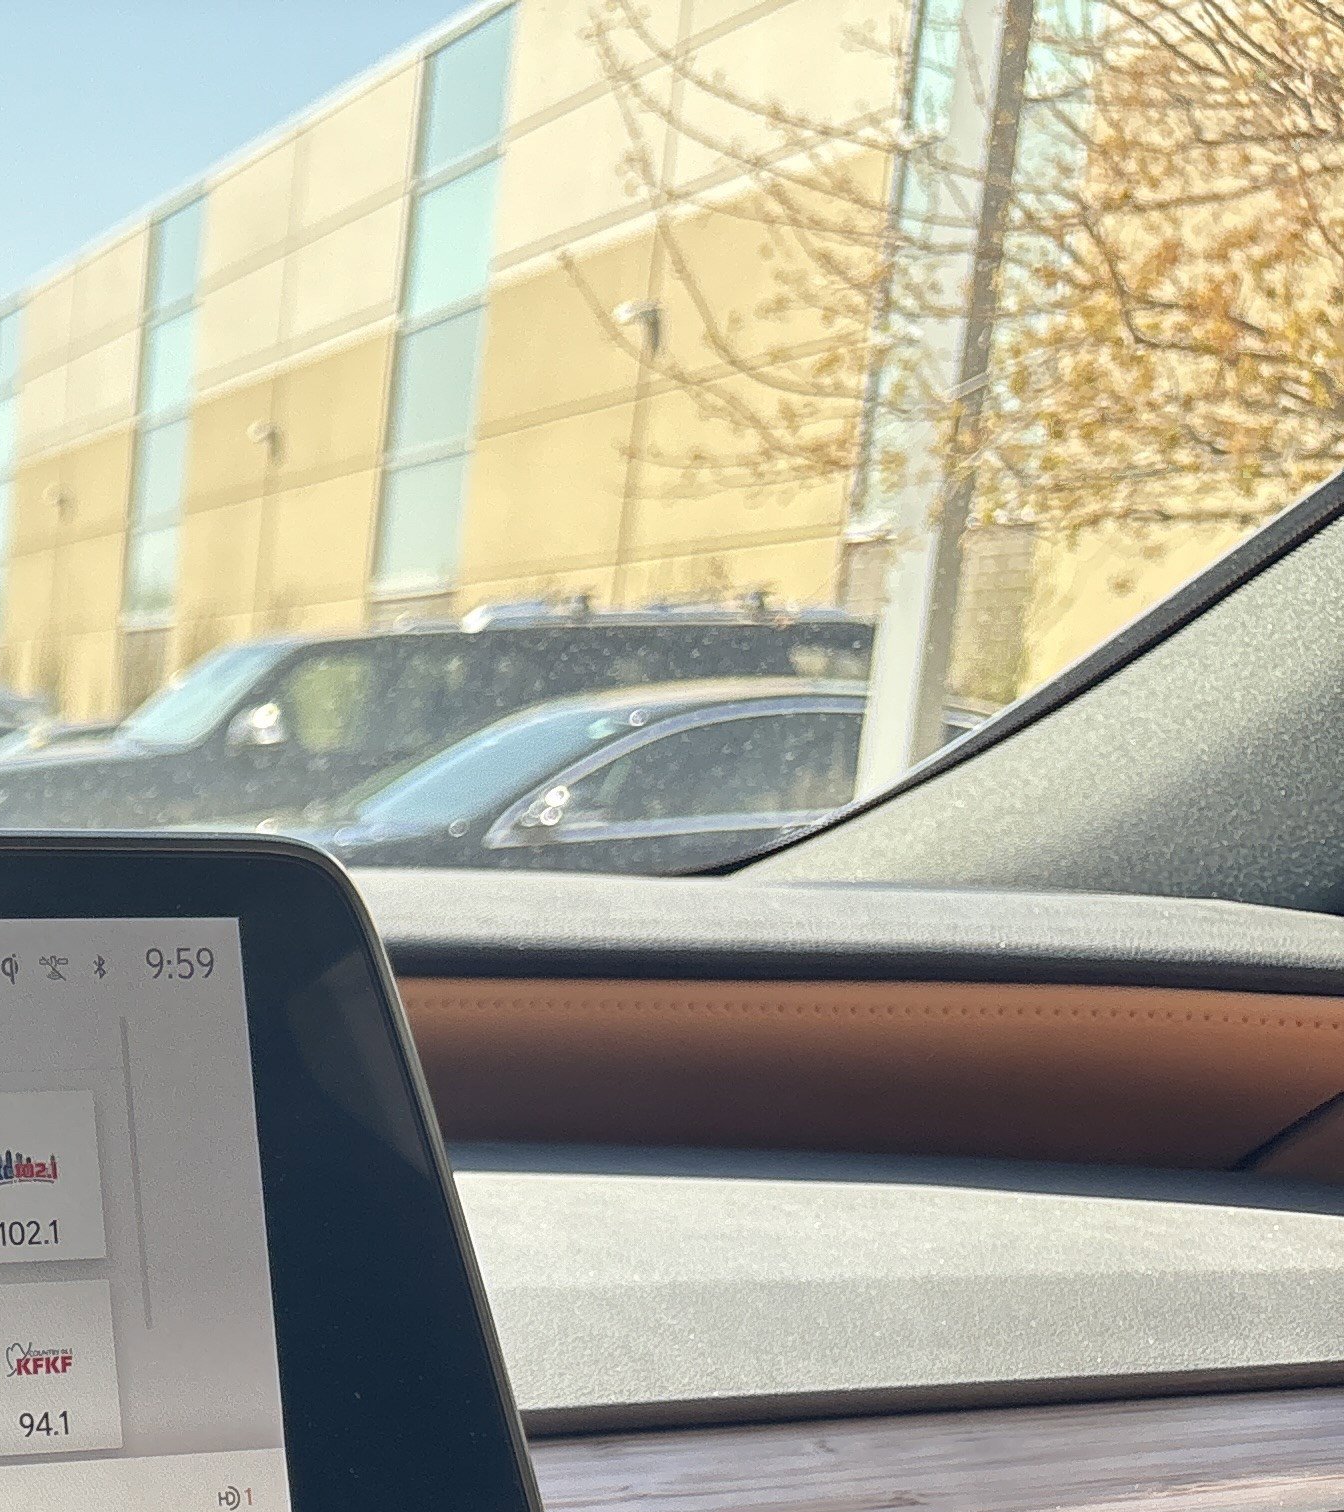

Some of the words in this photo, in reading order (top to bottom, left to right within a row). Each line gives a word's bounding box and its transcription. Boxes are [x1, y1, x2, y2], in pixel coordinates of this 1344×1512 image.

[145, 947, 215, 980] 9:59
[17, 1355, 72, 1376] KFKF
[19, 1410, 70, 1438] 94.1
